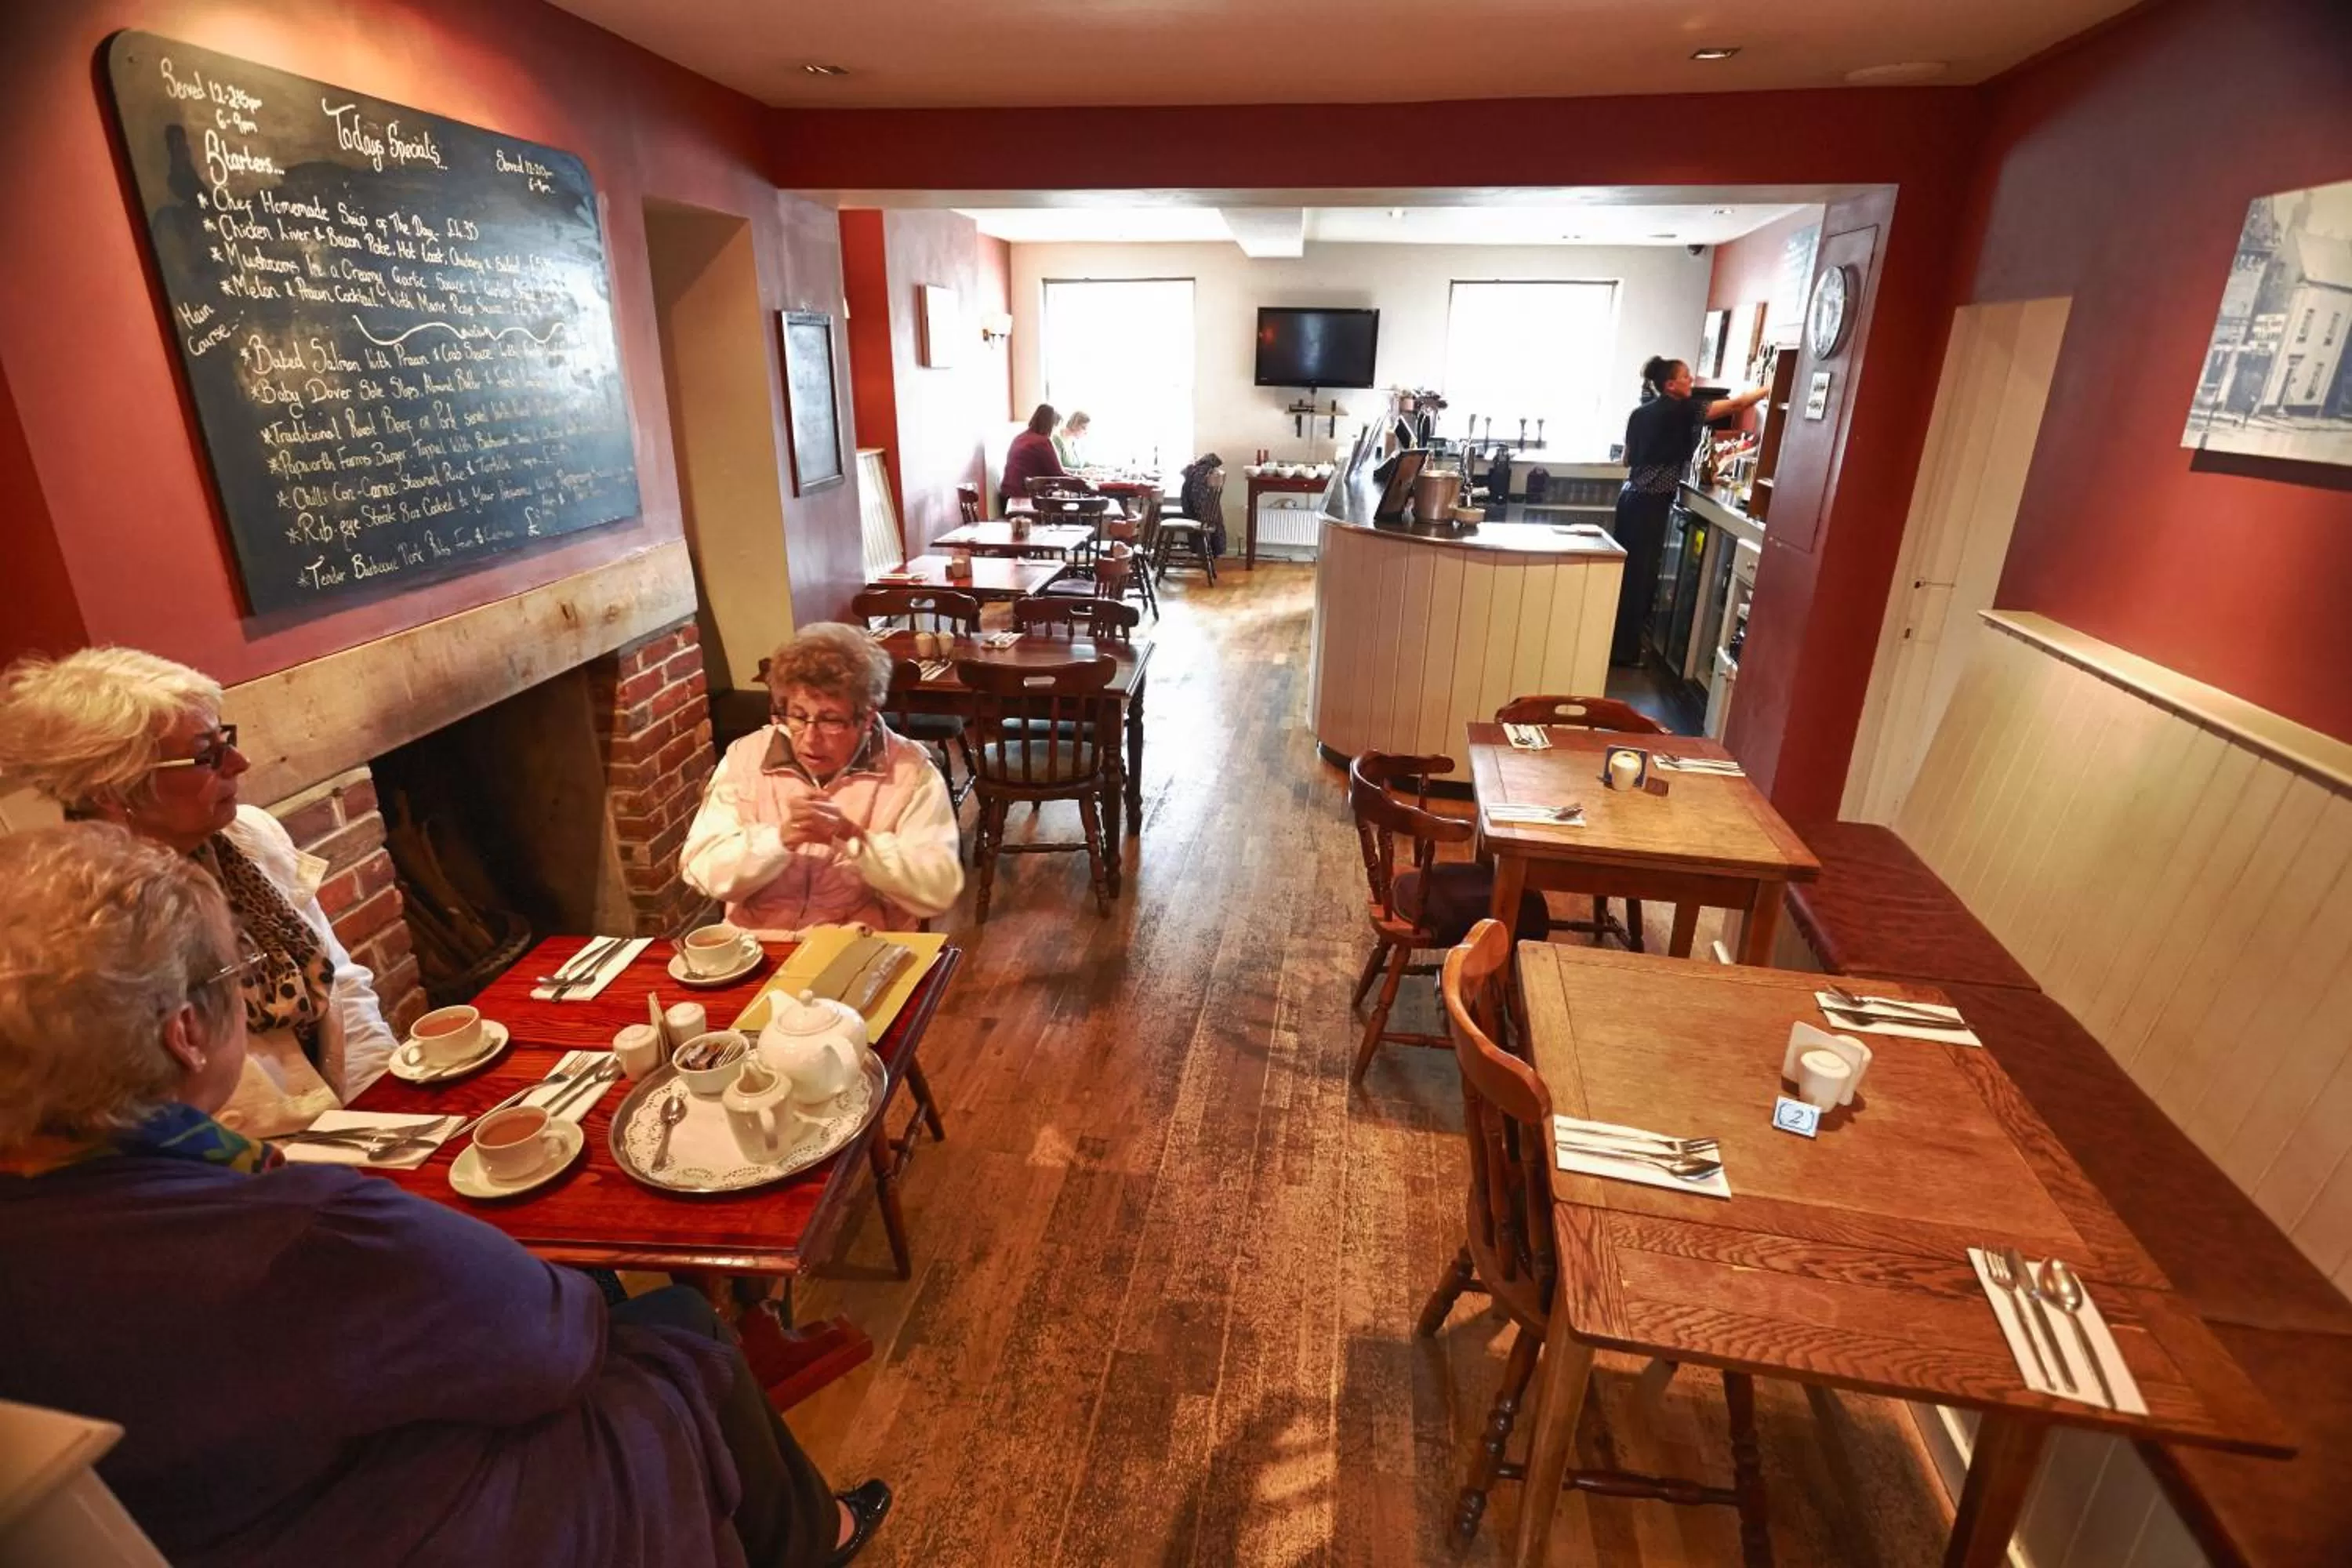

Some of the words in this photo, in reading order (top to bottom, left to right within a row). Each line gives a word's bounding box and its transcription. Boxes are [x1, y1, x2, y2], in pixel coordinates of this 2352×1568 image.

[161, 58, 206, 100] Served
[260, 190, 330, 221] Homemade
[338, 201, 368, 232] Soup
[389, 211, 411, 234] The
[219, 214, 274, 241] Chicken
[277, 218, 311, 241] Liver
[326, 226, 362, 249] Bacon
[231, 274, 281, 299] Melon
[178, 301, 215, 329] Main
[249, 334, 306, 375] Baked
[310, 338, 362, 373] Salmon
[259, 378, 304, 419] Baby
[306, 379, 352, 403] Dover
[270, 416, 342, 445] Traditional
[293, 486, 328, 510] Chilli
[361, 503, 396, 527] Steak
[305, 555, 346, 590] Tender
[1788, 1109, 1804, 1124] 2
